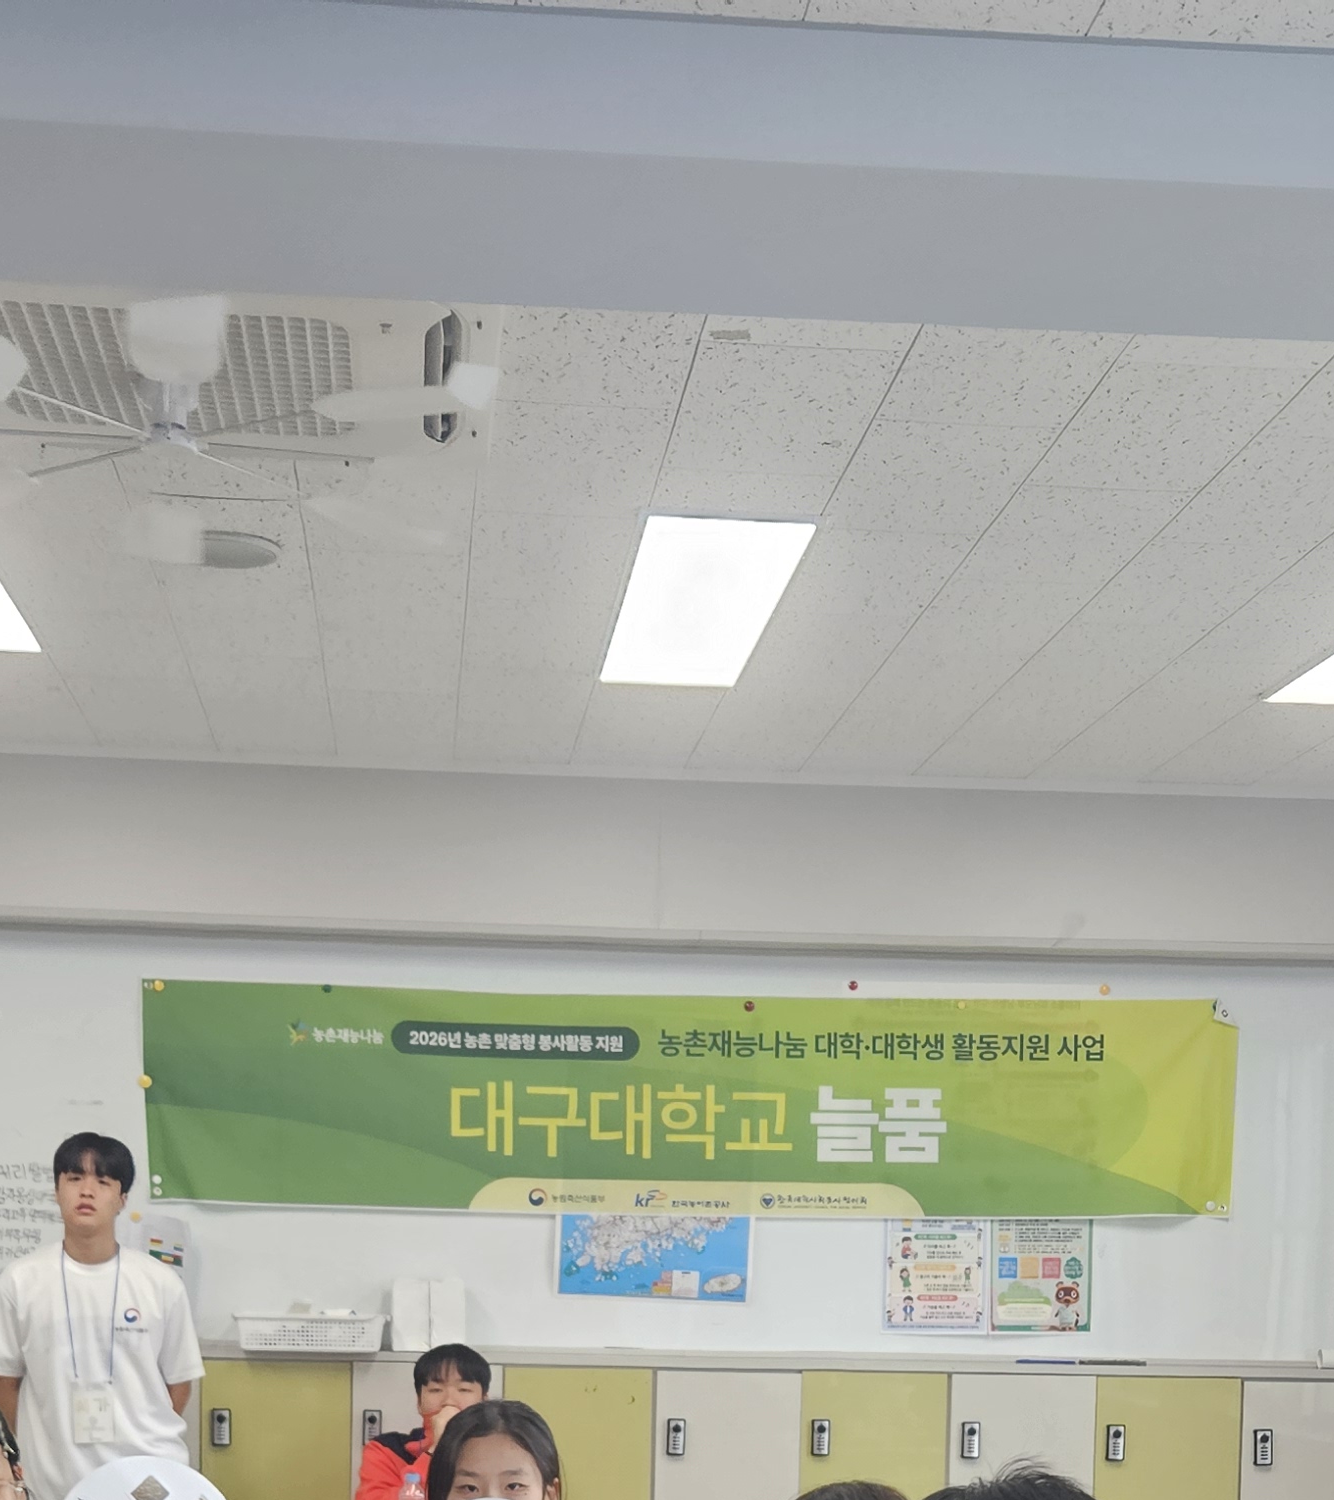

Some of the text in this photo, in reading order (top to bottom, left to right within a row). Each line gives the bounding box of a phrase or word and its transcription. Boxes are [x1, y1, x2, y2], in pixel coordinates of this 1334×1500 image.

[313, 1027, 385, 1045] 농촌재능나눔
[409, 1030, 624, 1053] 2026년 농촌 맞춤형 봉사활동 지원
[657, 1029, 1105, 1062] 농촌재능나눔 대학·대학생 활동지원 사업
[450, 1080, 947, 1163] 대구대학교 늘품
